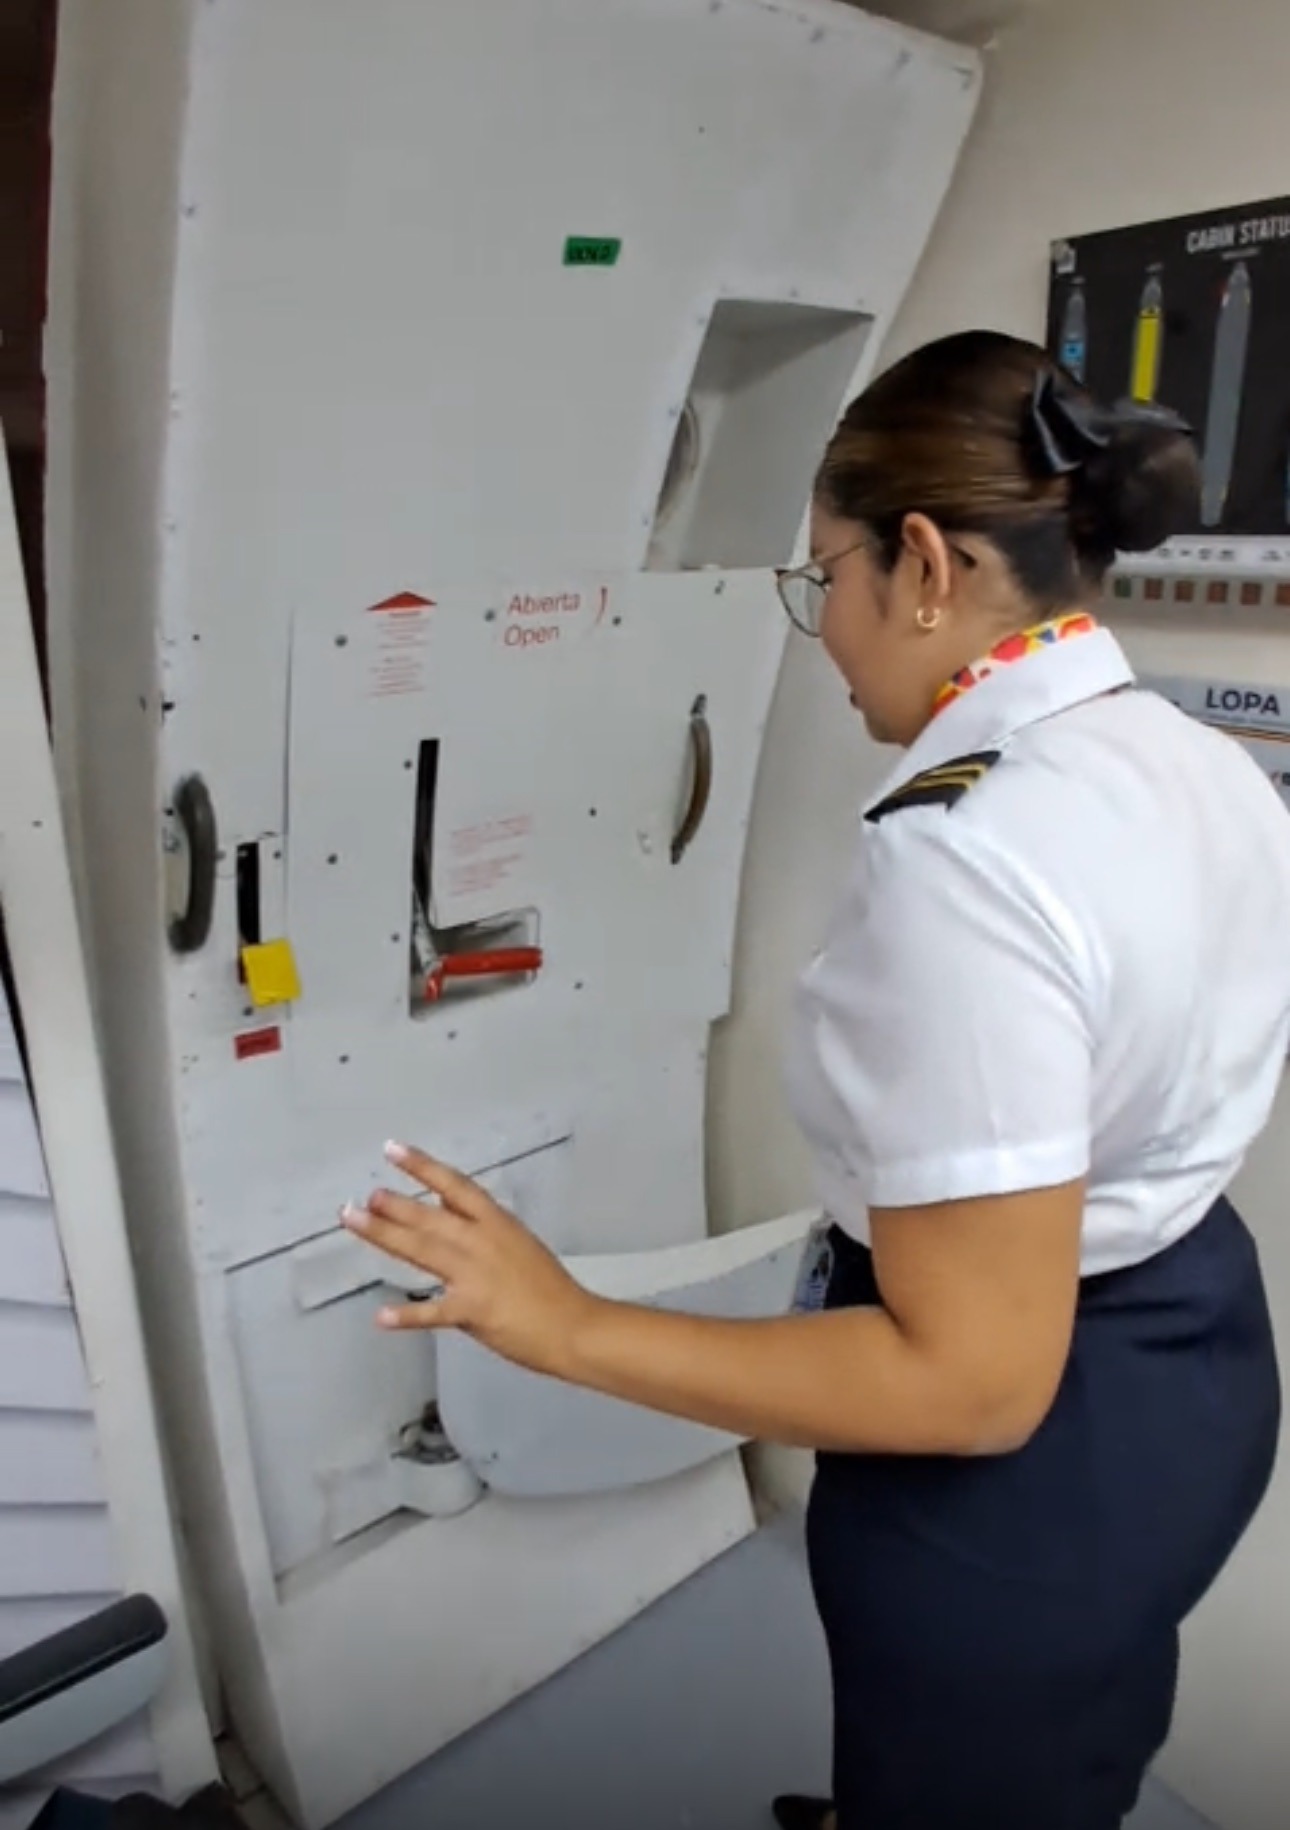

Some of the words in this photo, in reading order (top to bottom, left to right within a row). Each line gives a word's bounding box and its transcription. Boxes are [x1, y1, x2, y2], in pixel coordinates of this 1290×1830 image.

[508, 593, 581, 614] Abierta
[504, 624, 559, 647] Open
[1205, 687, 1280, 716] LOPA
